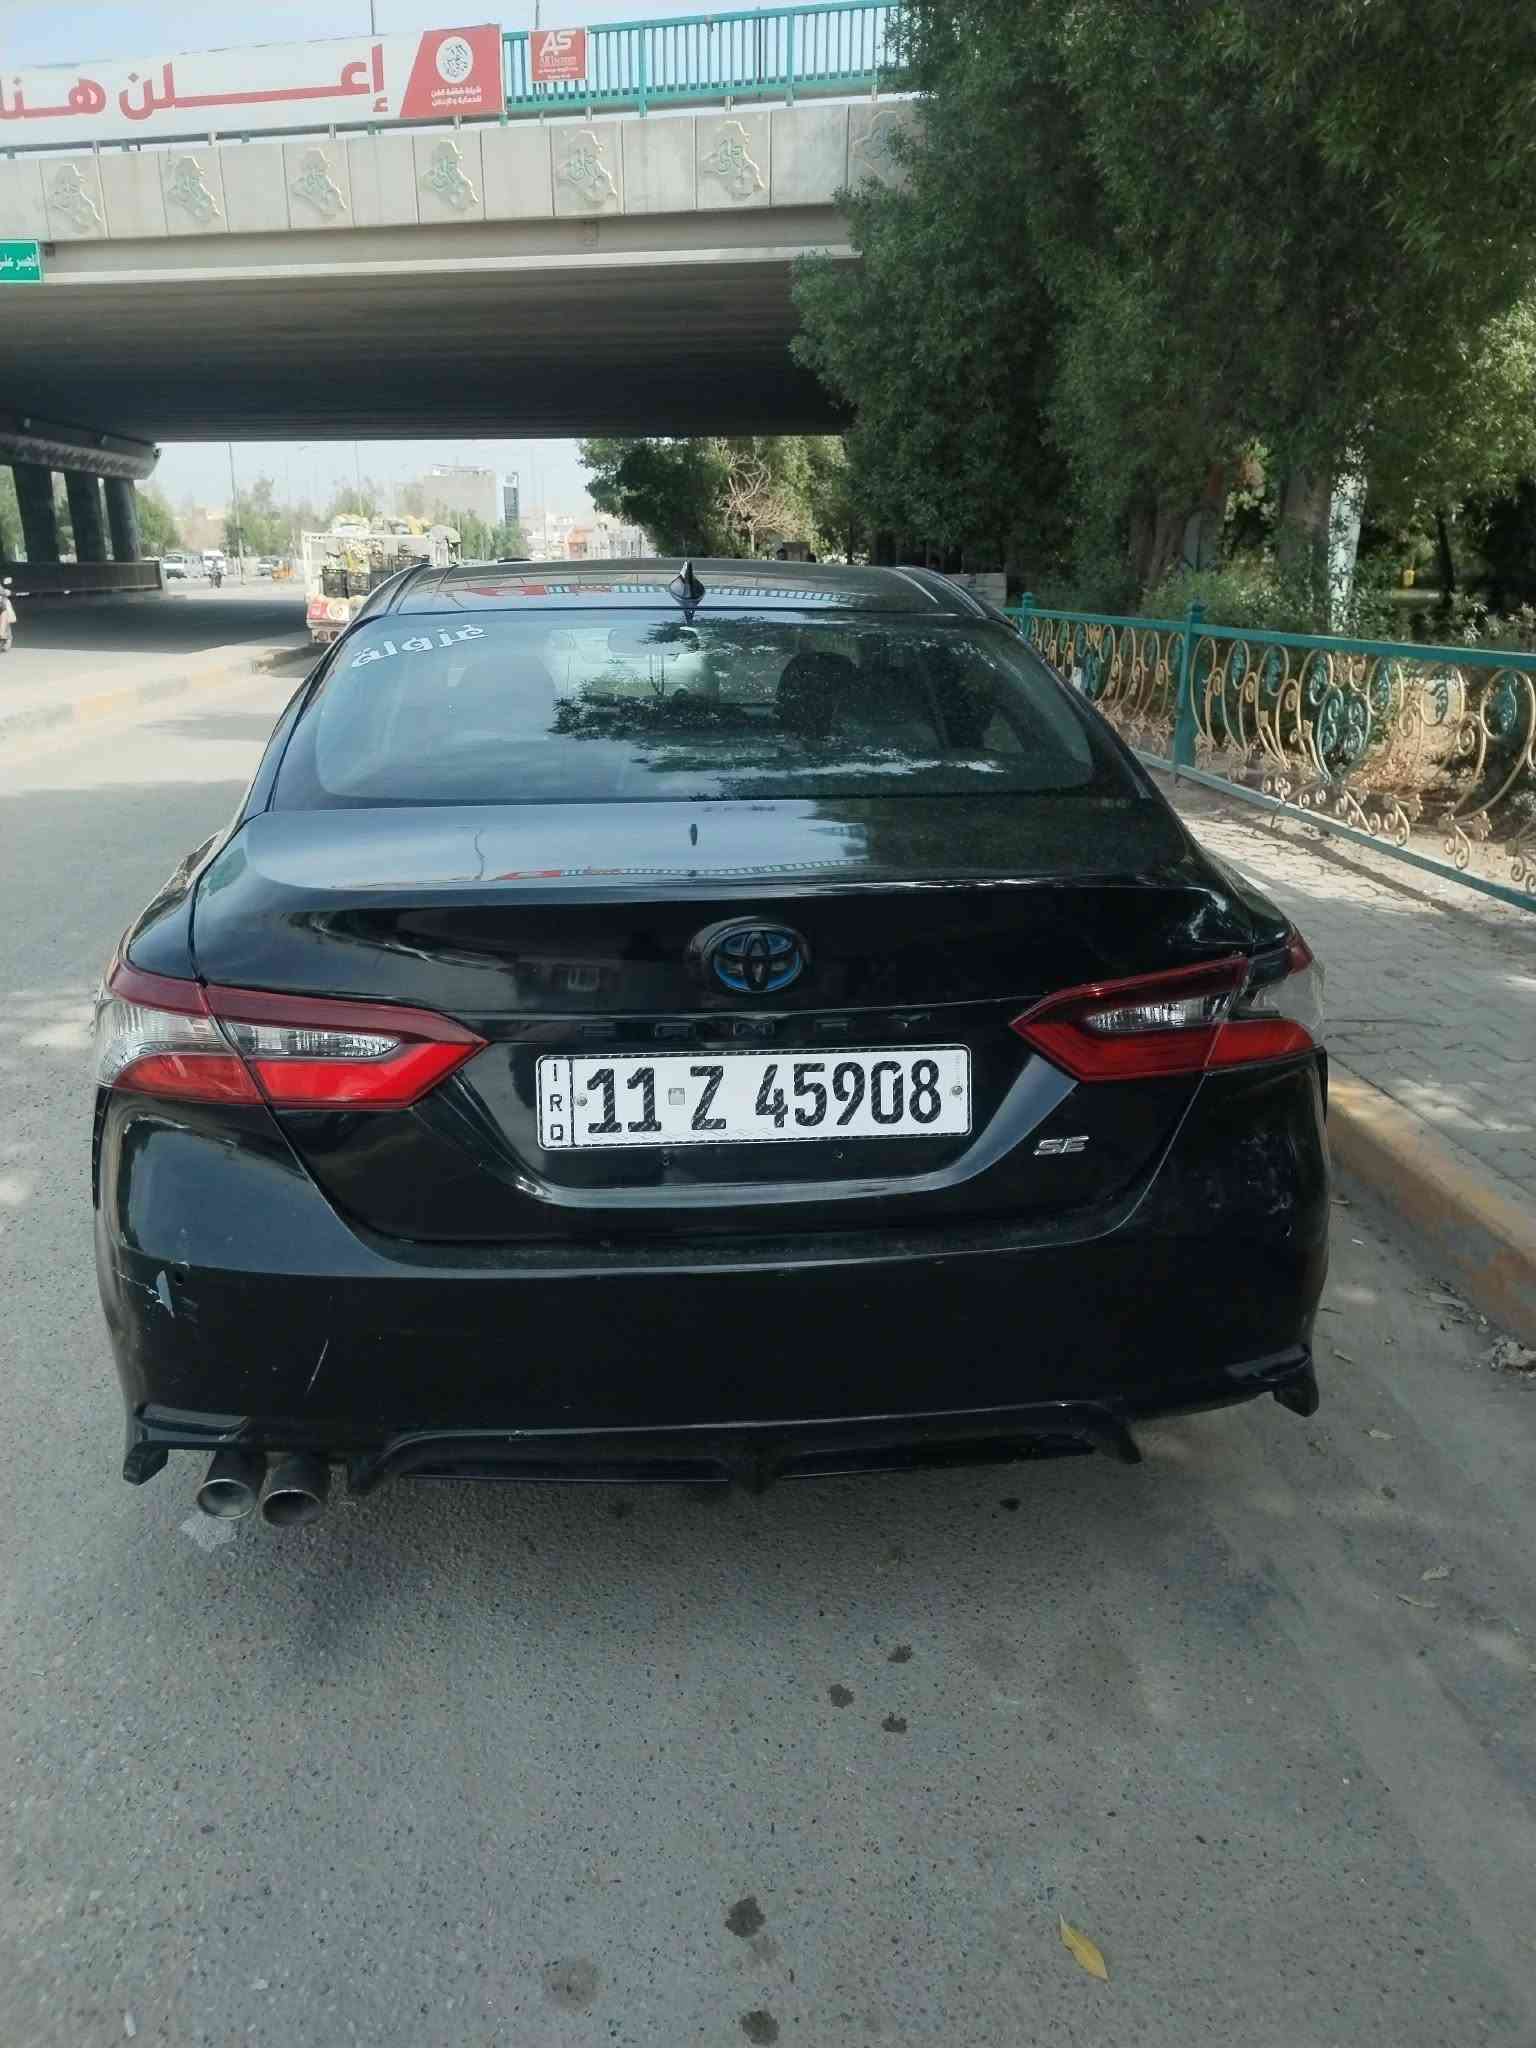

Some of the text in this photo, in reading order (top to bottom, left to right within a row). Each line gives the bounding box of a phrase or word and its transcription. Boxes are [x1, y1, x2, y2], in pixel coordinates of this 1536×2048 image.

[587, 1067, 662, 1134] 11
[690, 1065, 727, 1130] Z
[755, 1059, 942, 1128] 45908
[1033, 1136, 1090, 1156] SE
